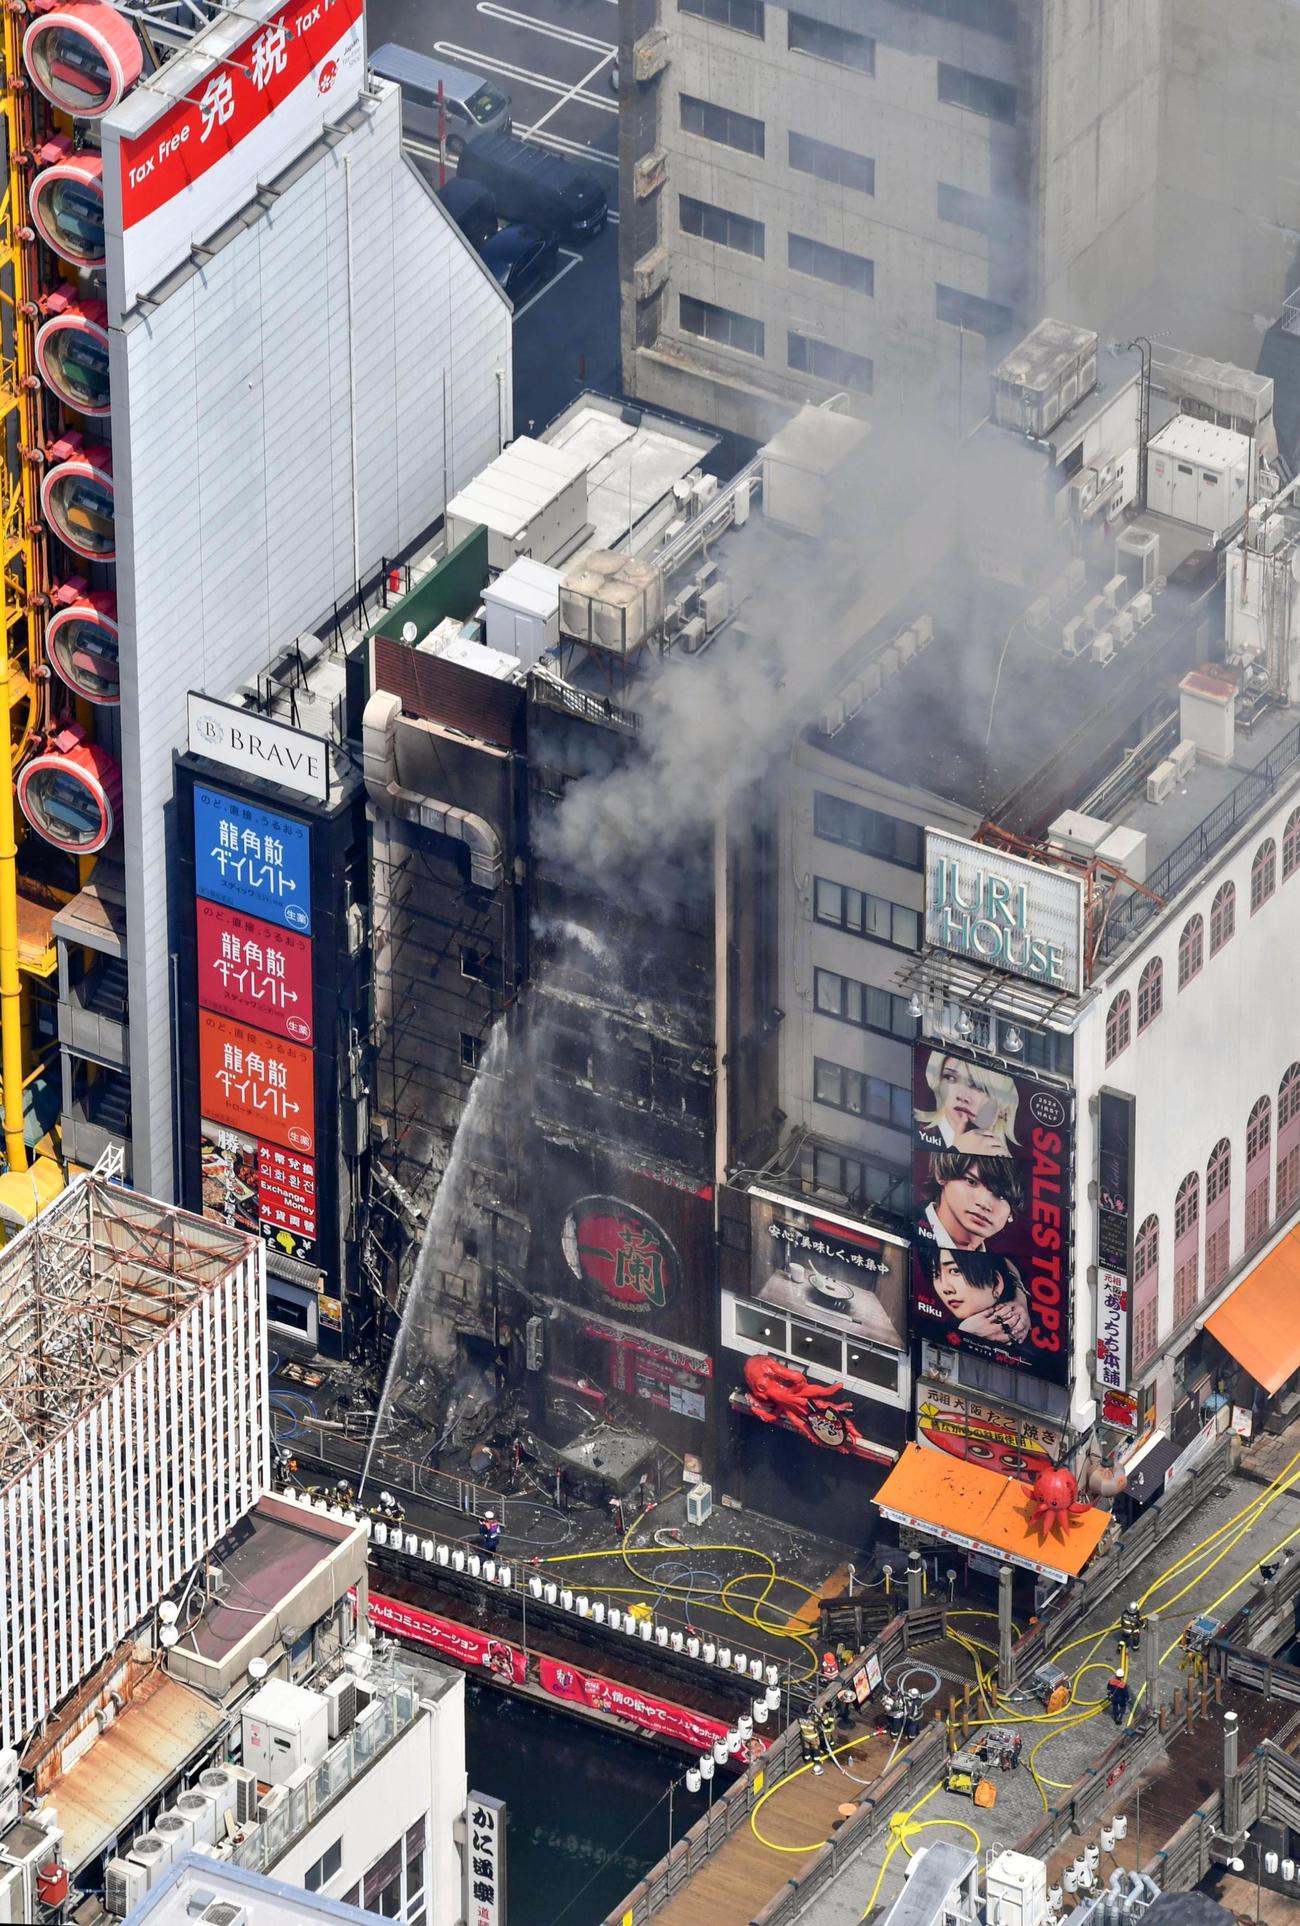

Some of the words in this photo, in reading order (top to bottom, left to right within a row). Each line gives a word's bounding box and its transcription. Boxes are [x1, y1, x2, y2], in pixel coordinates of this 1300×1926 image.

[295, 4, 321, 37] Tax
[200, 16, 289, 144] 免税
[128, 160, 155, 188] Tax
[158, 124, 190, 163] Free
[205, 721, 217, 738] B
[230, 728, 319, 780] BRAVE
[218, 819, 284, 868] 龍角散
[210, 847, 296, 897] ダイレクト
[932, 856, 1028, 930] JURI
[221, 931, 286, 980] 龍角散
[943, 907, 1066, 981] HOUSE
[213, 959, 299, 1009] ダイレクト
[223, 1042, 288, 1091] 龍角散
[215, 1070, 300, 1119] ダイレクト
[918, 1130, 943, 1147] Yuki
[260, 1164, 314, 1194] 외화환전
[260, 1180, 306, 1204] Exchange
[1031, 1126, 1062, 1251] SALES
[284, 1198, 315, 1216] Money
[577, 1225, 667, 1308] 一蘭
[768, 1224, 889, 1276] 安心、美味しく、味集中
[1103, 1273, 1122, 1287] 元祖
[917, 1301, 943, 1318] Riku
[1103, 1293, 1121, 1388] あっちち本舗
[927, 1389, 1057, 1446] 元祖大阪たこ焼き
